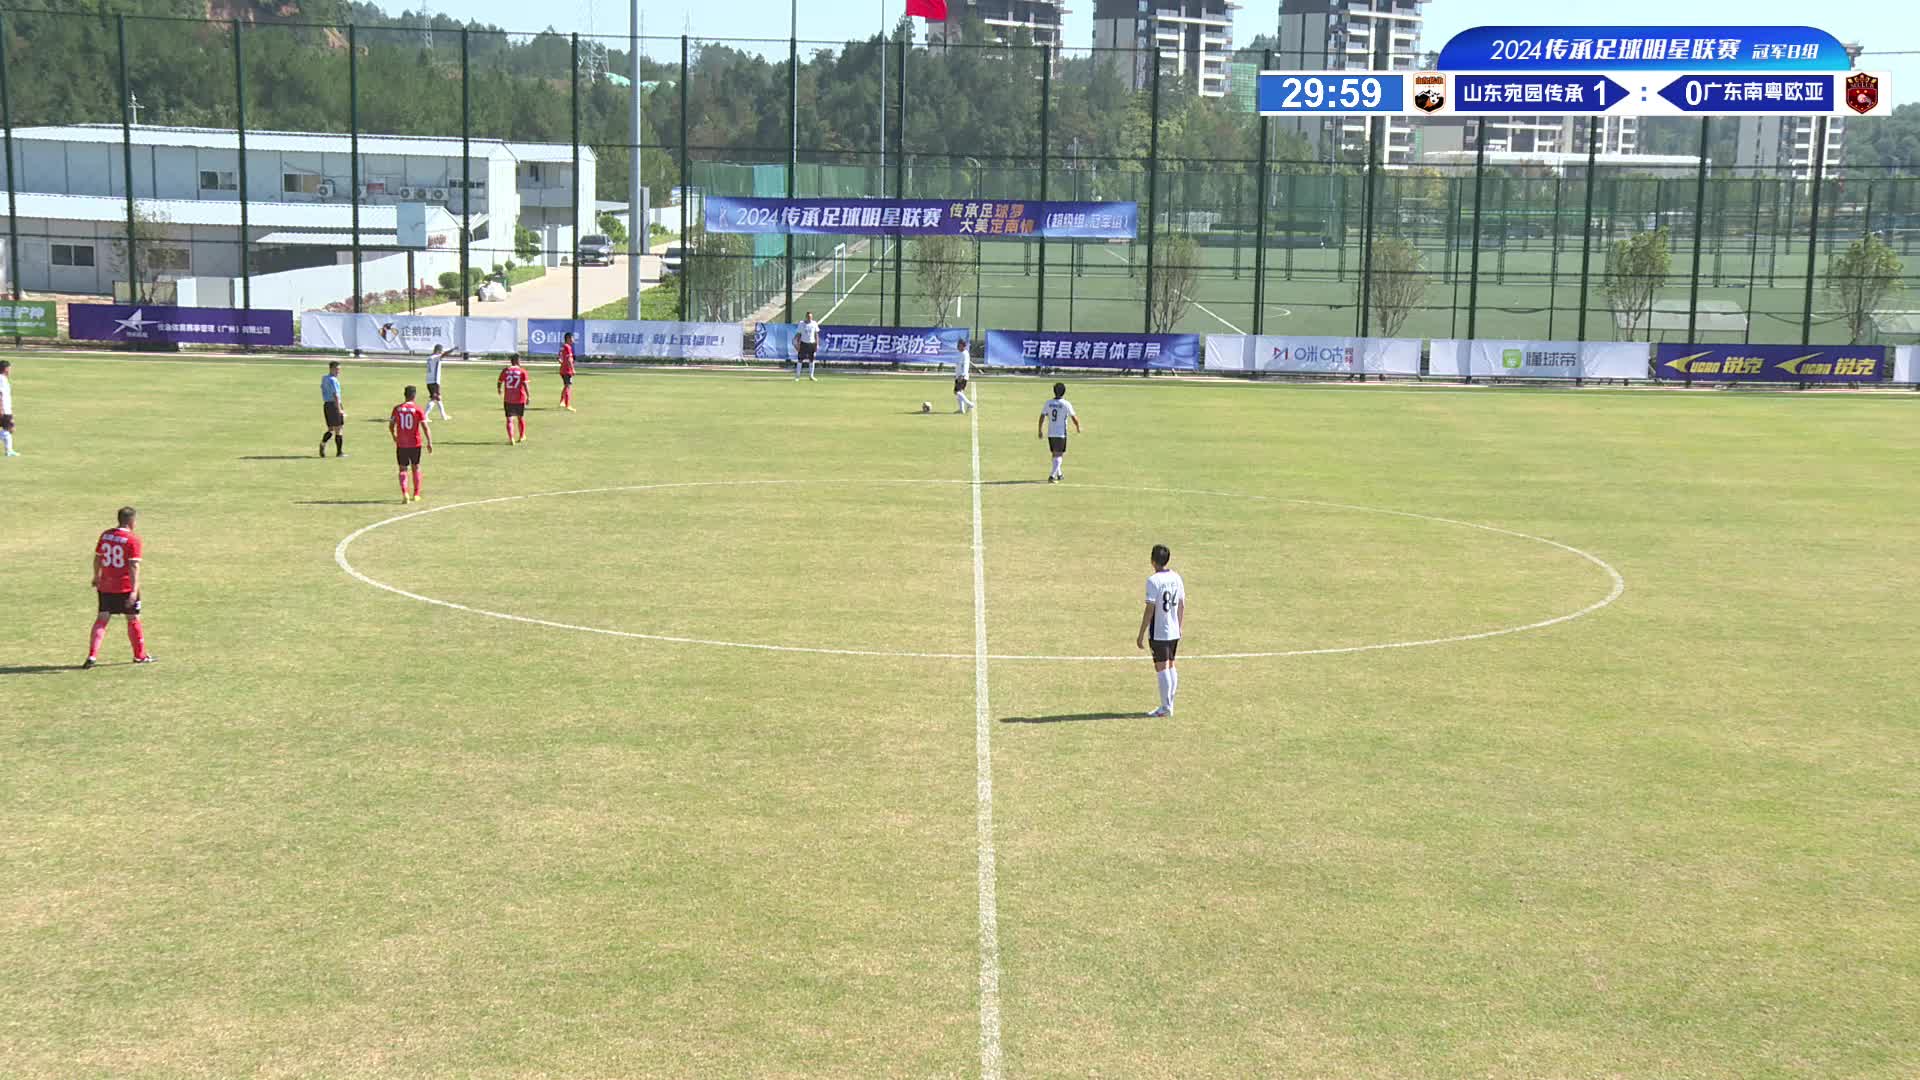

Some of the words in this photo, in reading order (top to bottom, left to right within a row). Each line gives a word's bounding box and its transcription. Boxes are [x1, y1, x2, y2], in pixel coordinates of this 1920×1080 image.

[736, 206, 943, 228] 2024传承足球明星联赛
[401, 326, 442, 337] 企鹅体育
[825, 333, 941, 354] 江西省足球协会
[1022, 340, 1161, 360] 定南县教育体育局
[1526, 352, 1577, 367] 懂球帝
[505, 375, 521, 389] 27
[399, 412, 414, 430] 10
[1051, 408, 1058, 422] 9
[101, 542, 125, 568] 38
